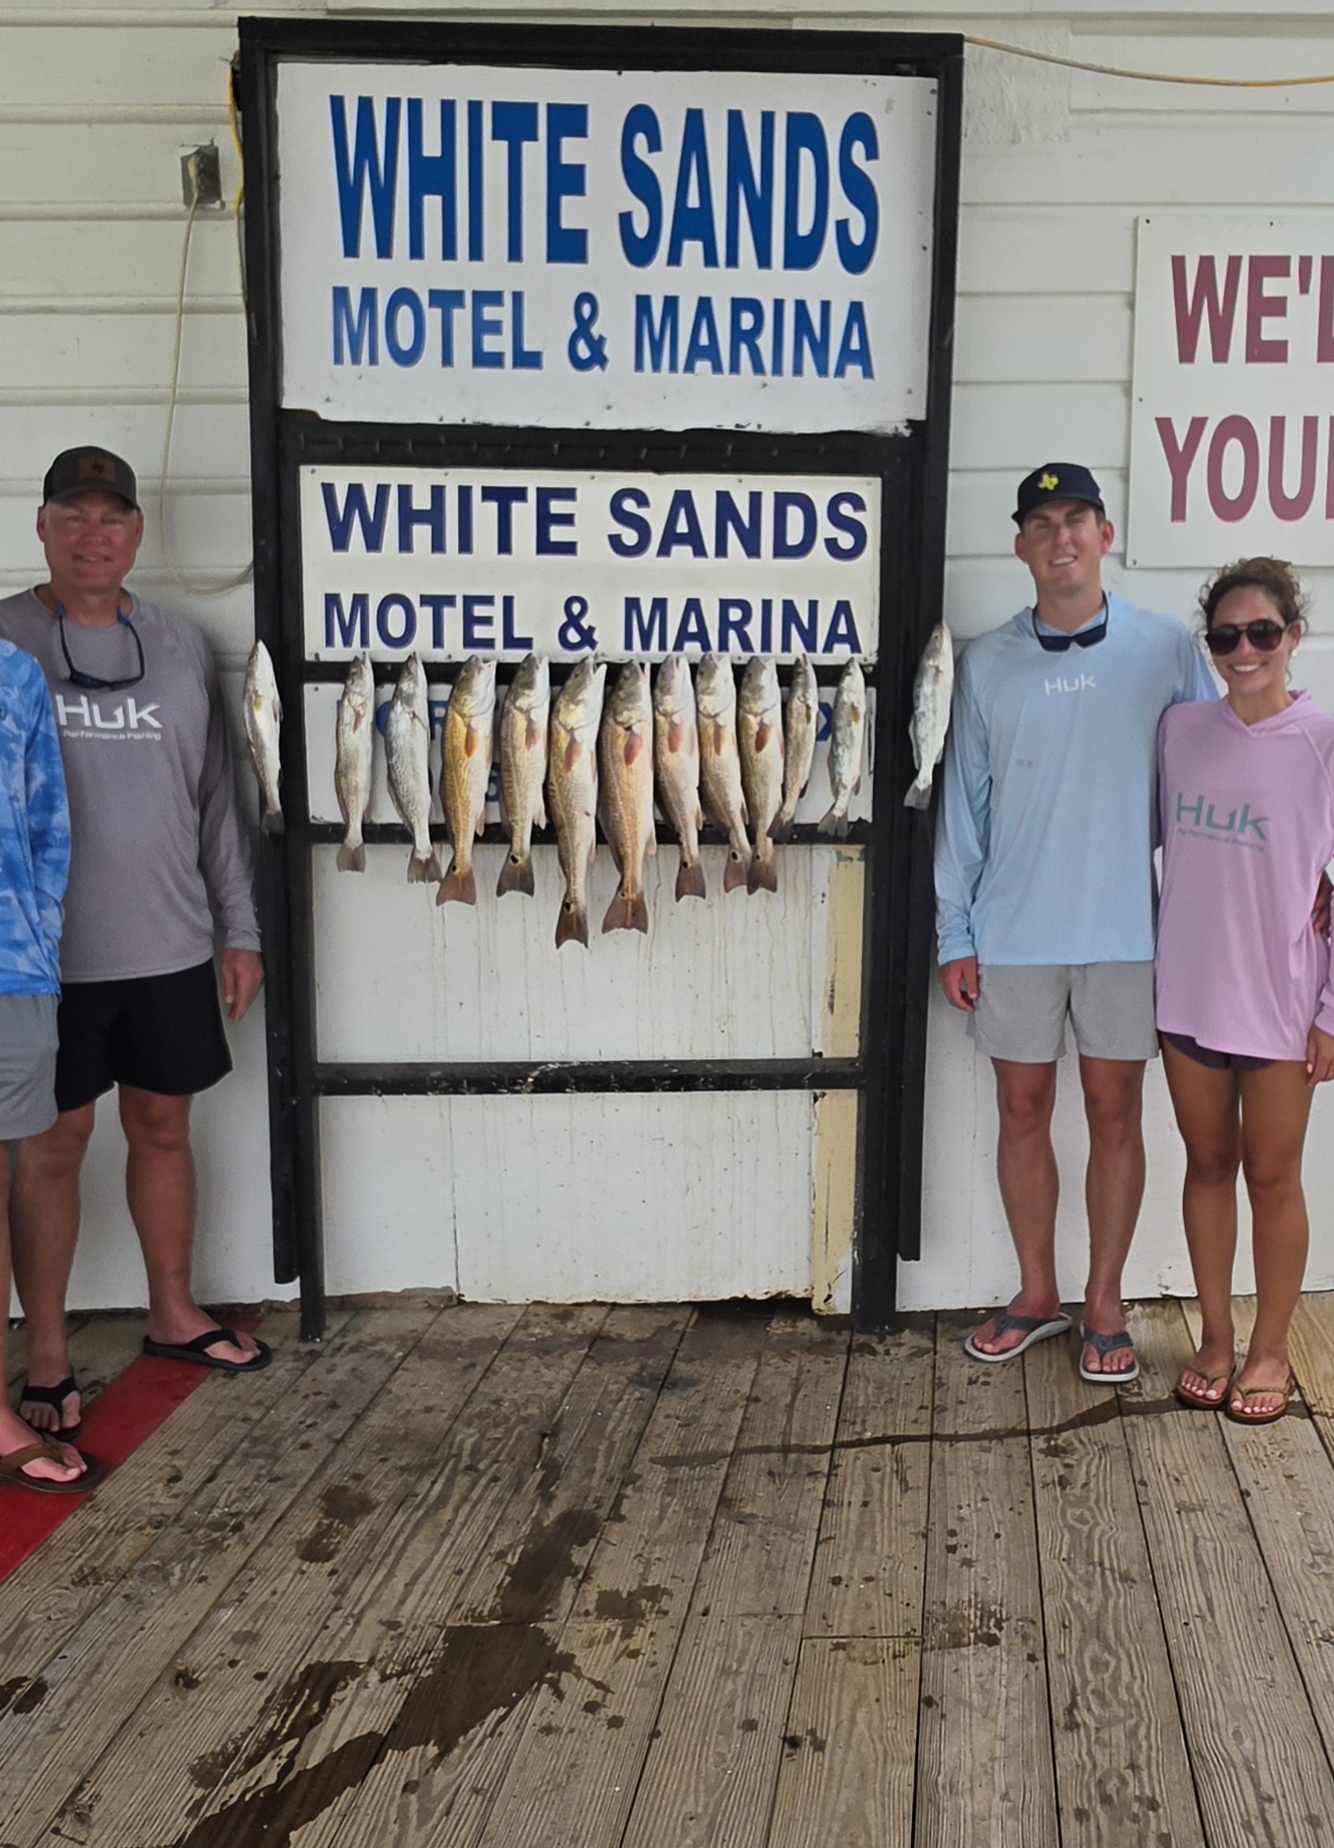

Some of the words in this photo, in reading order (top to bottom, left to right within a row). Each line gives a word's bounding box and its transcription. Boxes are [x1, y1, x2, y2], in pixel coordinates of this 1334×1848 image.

[329, 94, 589, 264] WHITE
[618, 103, 880, 275] SANDS
[331, 285, 544, 370] MOTEL
[567, 291, 609, 372] &
[633, 294, 874, 379] MARINA
[321, 482, 580, 556] WHITE
[606, 487, 869, 562] SANDS
[323, 592, 534, 650] MOTEL
[557, 595, 597, 651] &
[623, 596, 863, 655] MARINA
